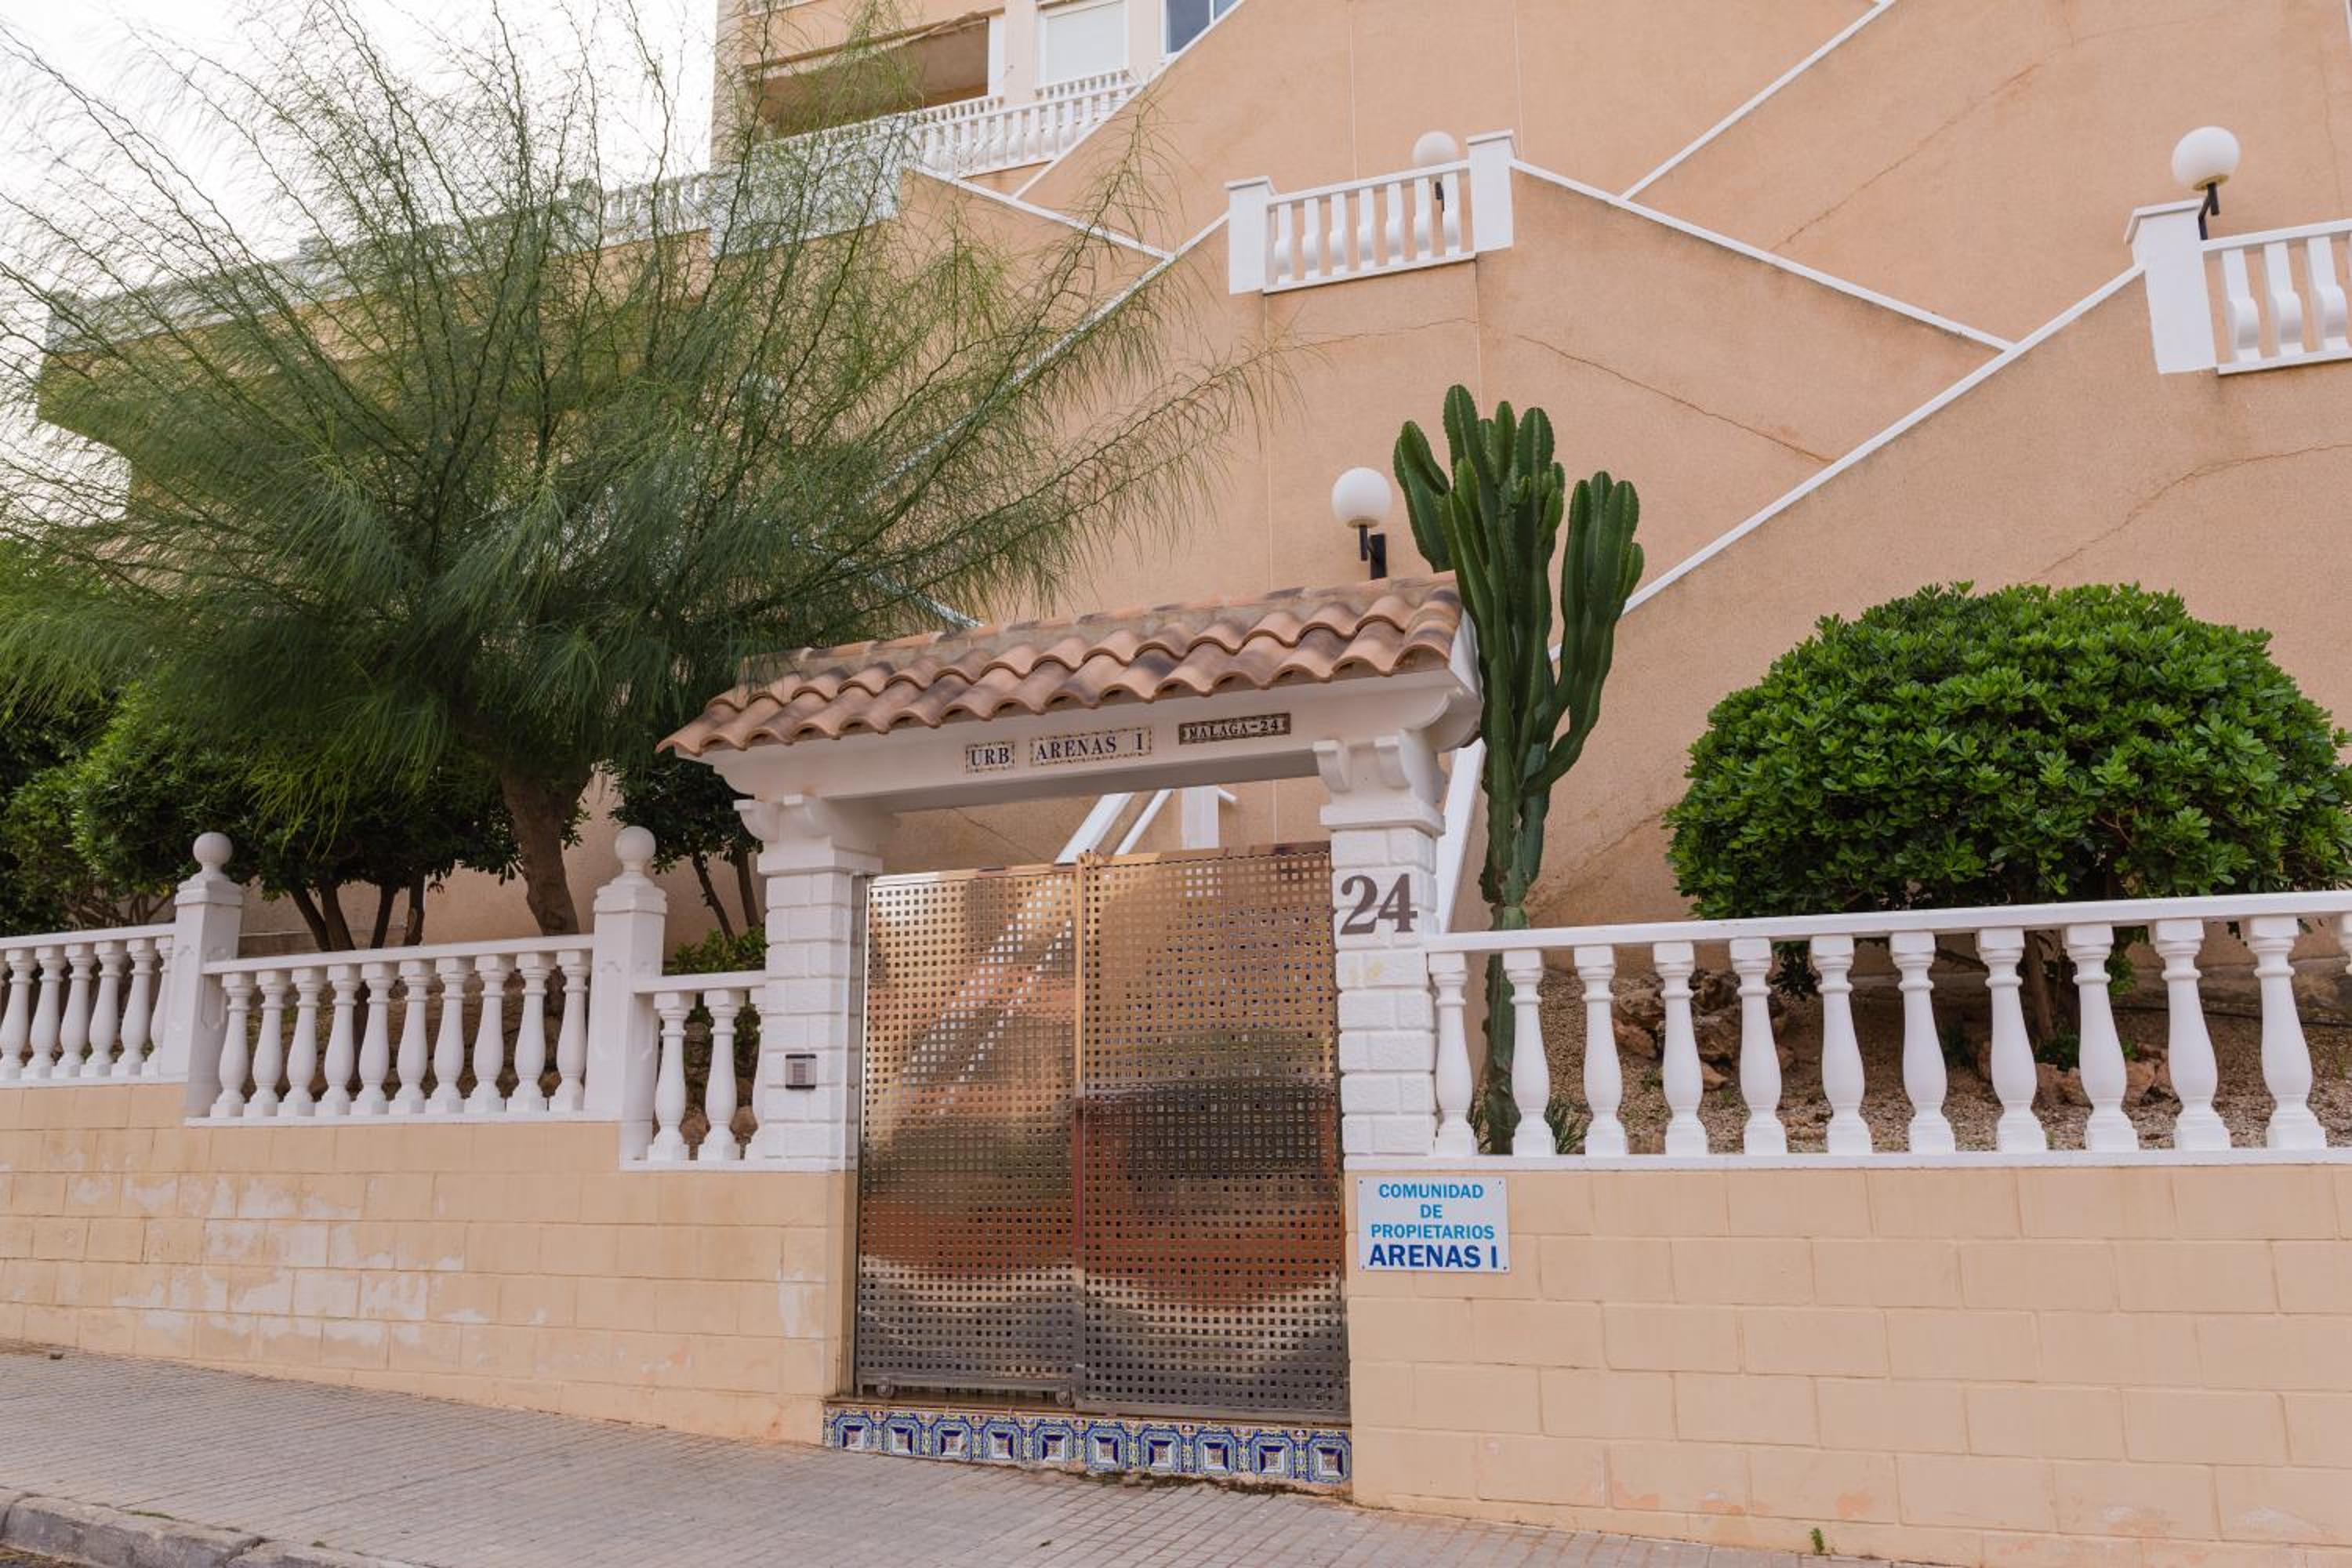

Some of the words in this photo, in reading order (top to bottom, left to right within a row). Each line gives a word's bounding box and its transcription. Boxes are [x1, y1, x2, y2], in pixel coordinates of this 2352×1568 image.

[971, 747, 1010, 767] URB
[1036, 735, 1117, 760] ARENAS
[1136, 733, 1143, 750] I
[1340, 873, 1418, 935] 24
[1379, 1184, 1484, 1198] COMUNIDAD
[1420, 1204, 1443, 1218] DE
[1370, 1224, 1495, 1240] PROPIETARIOS
[1369, 1243, 1481, 1268] ARENAS
[1491, 1245, 1497, 1269] I
